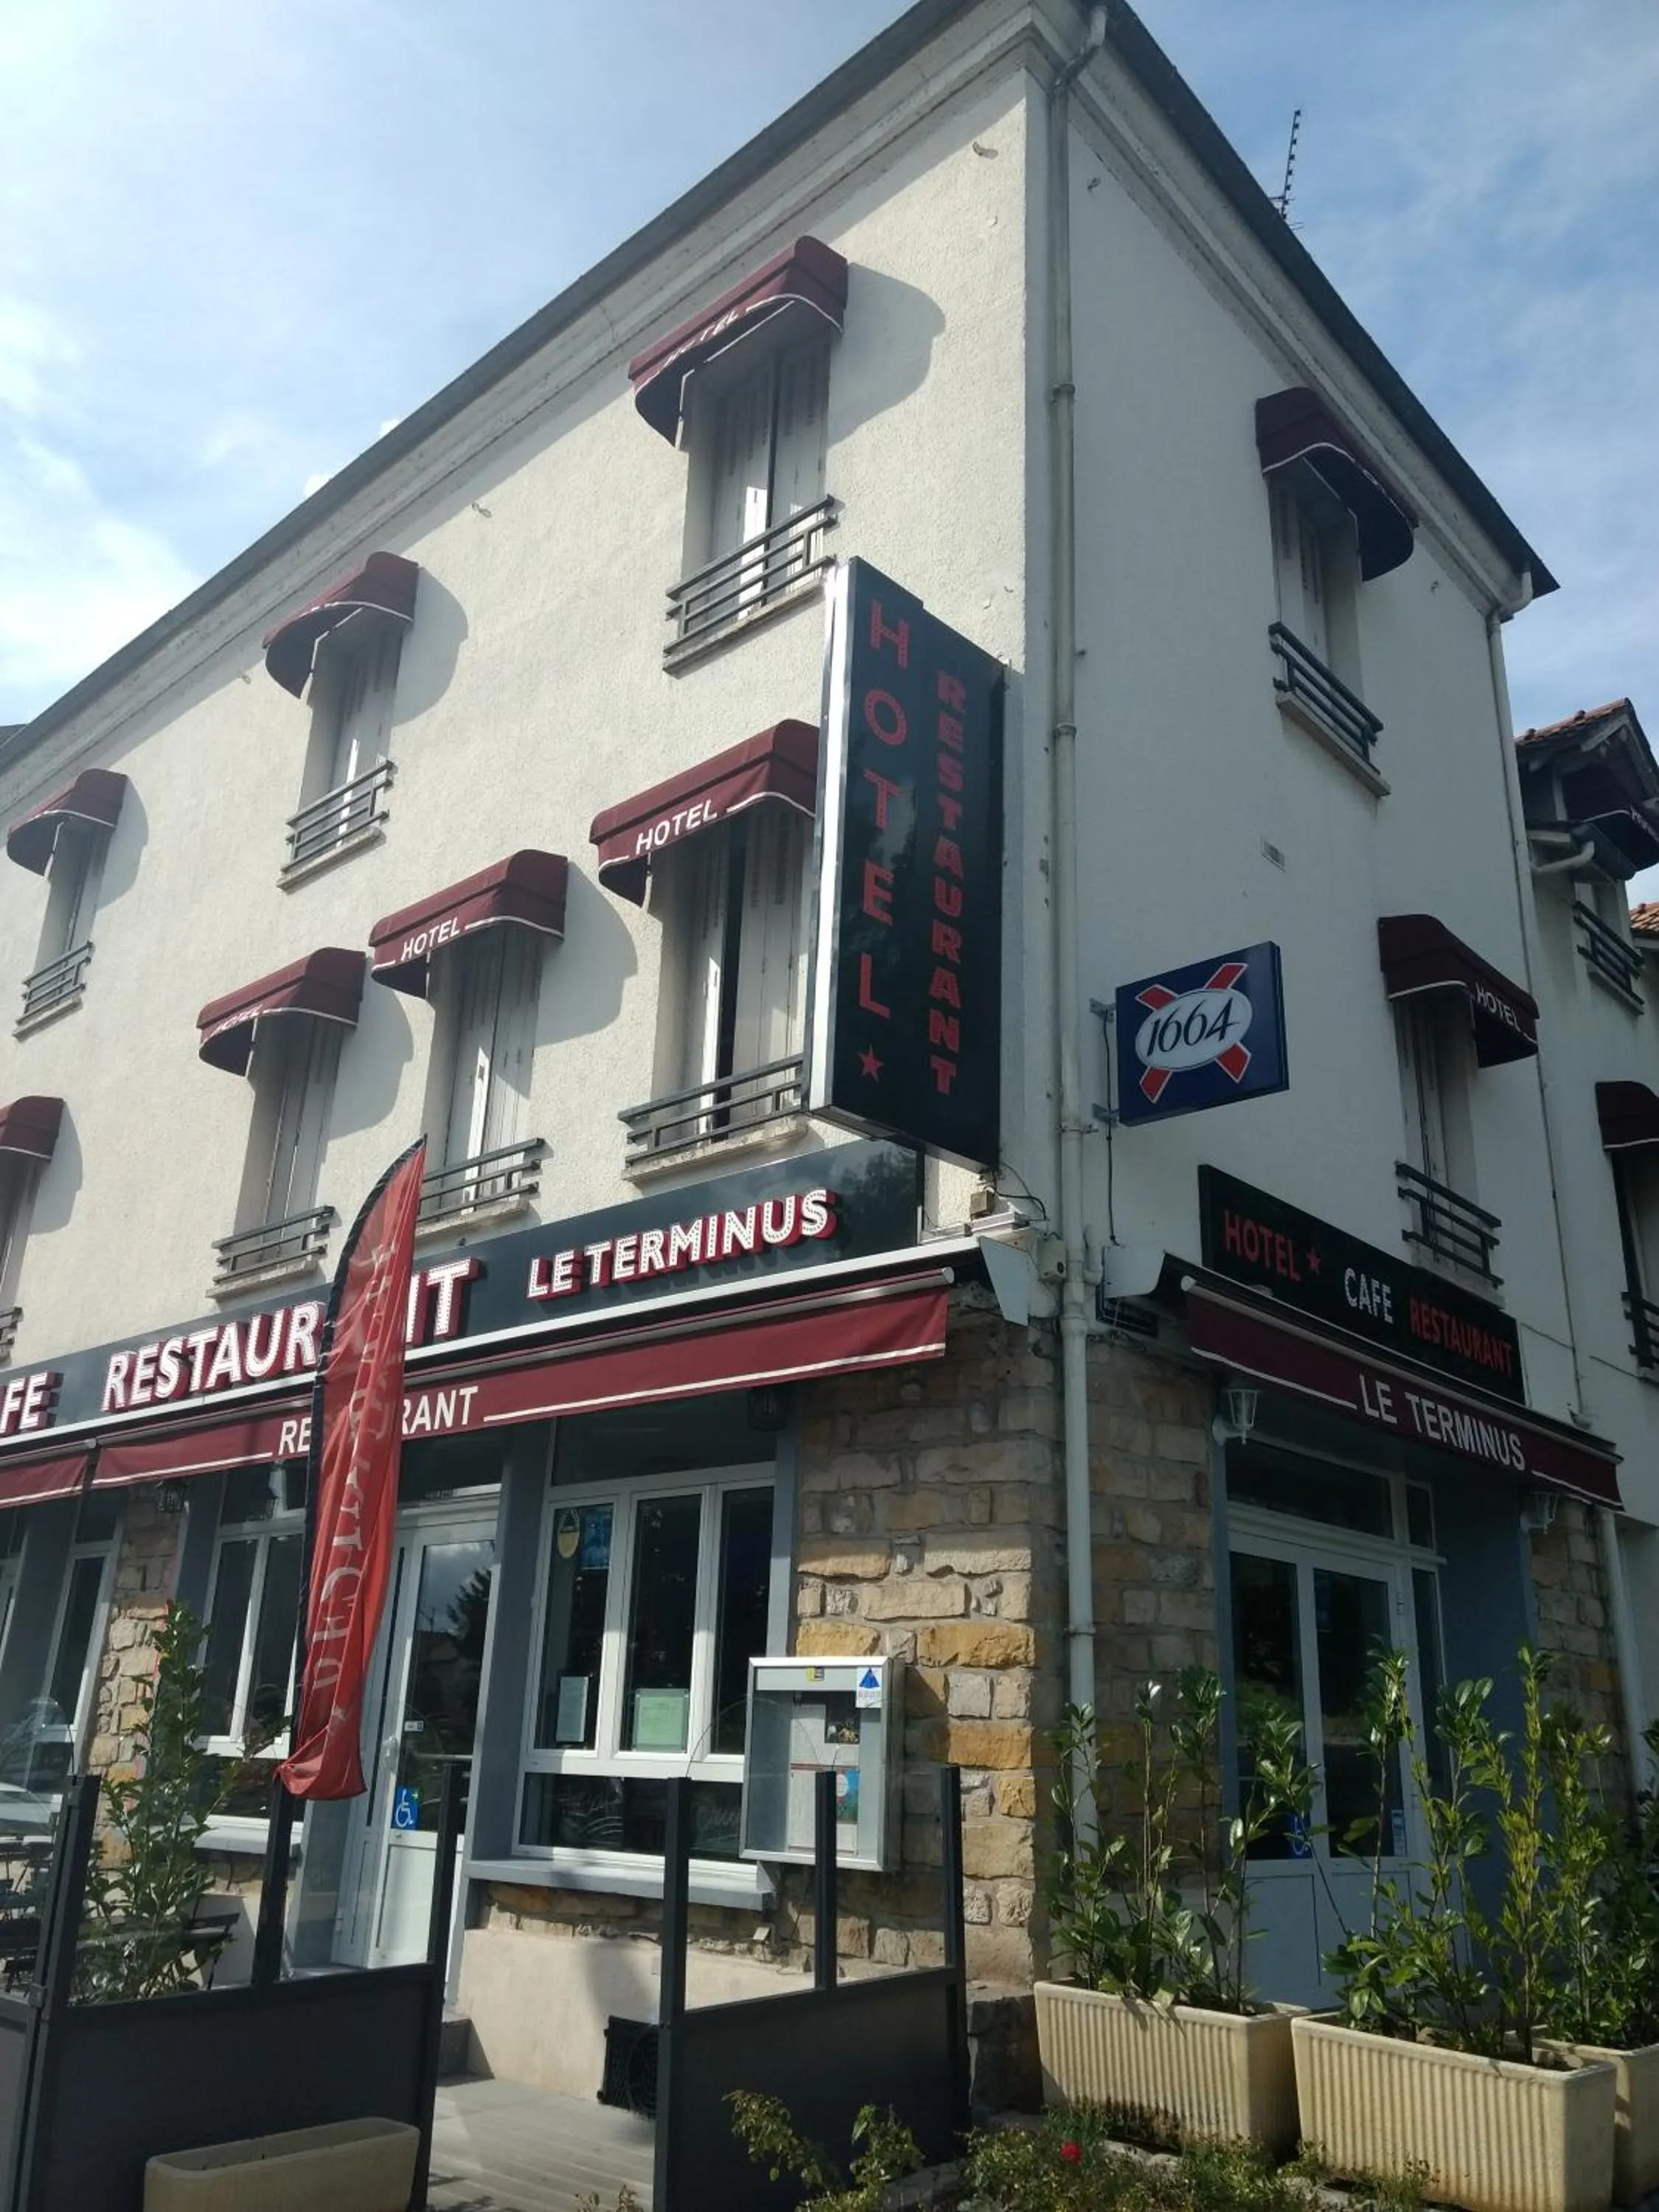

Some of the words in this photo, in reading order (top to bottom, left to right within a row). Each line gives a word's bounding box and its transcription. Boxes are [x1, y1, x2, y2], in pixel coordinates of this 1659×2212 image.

[635, 799, 718, 855] HOTEL
[859, 599, 911, 1019] HOTEL
[929, 670, 966, 1095] RESTAURANT
[400, 917, 461, 961] HOTEL
[1147, 996, 1240, 1057] 1664
[1475, 981, 1521, 1032] HOTEL
[526, 1250, 581, 1301] LE
[585, 1189, 836, 1287] TERMINUS
[1224, 1209, 1301, 1282] HOTEL
[1344, 1267, 1394, 1324] CAFE
[1410, 1296, 1512, 1378] RESTAURANT
[100, 1256, 483, 1413] RESTAURT
[278, 1385, 479, 1455] RERANT
[1359, 1374, 1398, 1425] LE
[1405, 1391, 1526, 1471] TERMINUS
